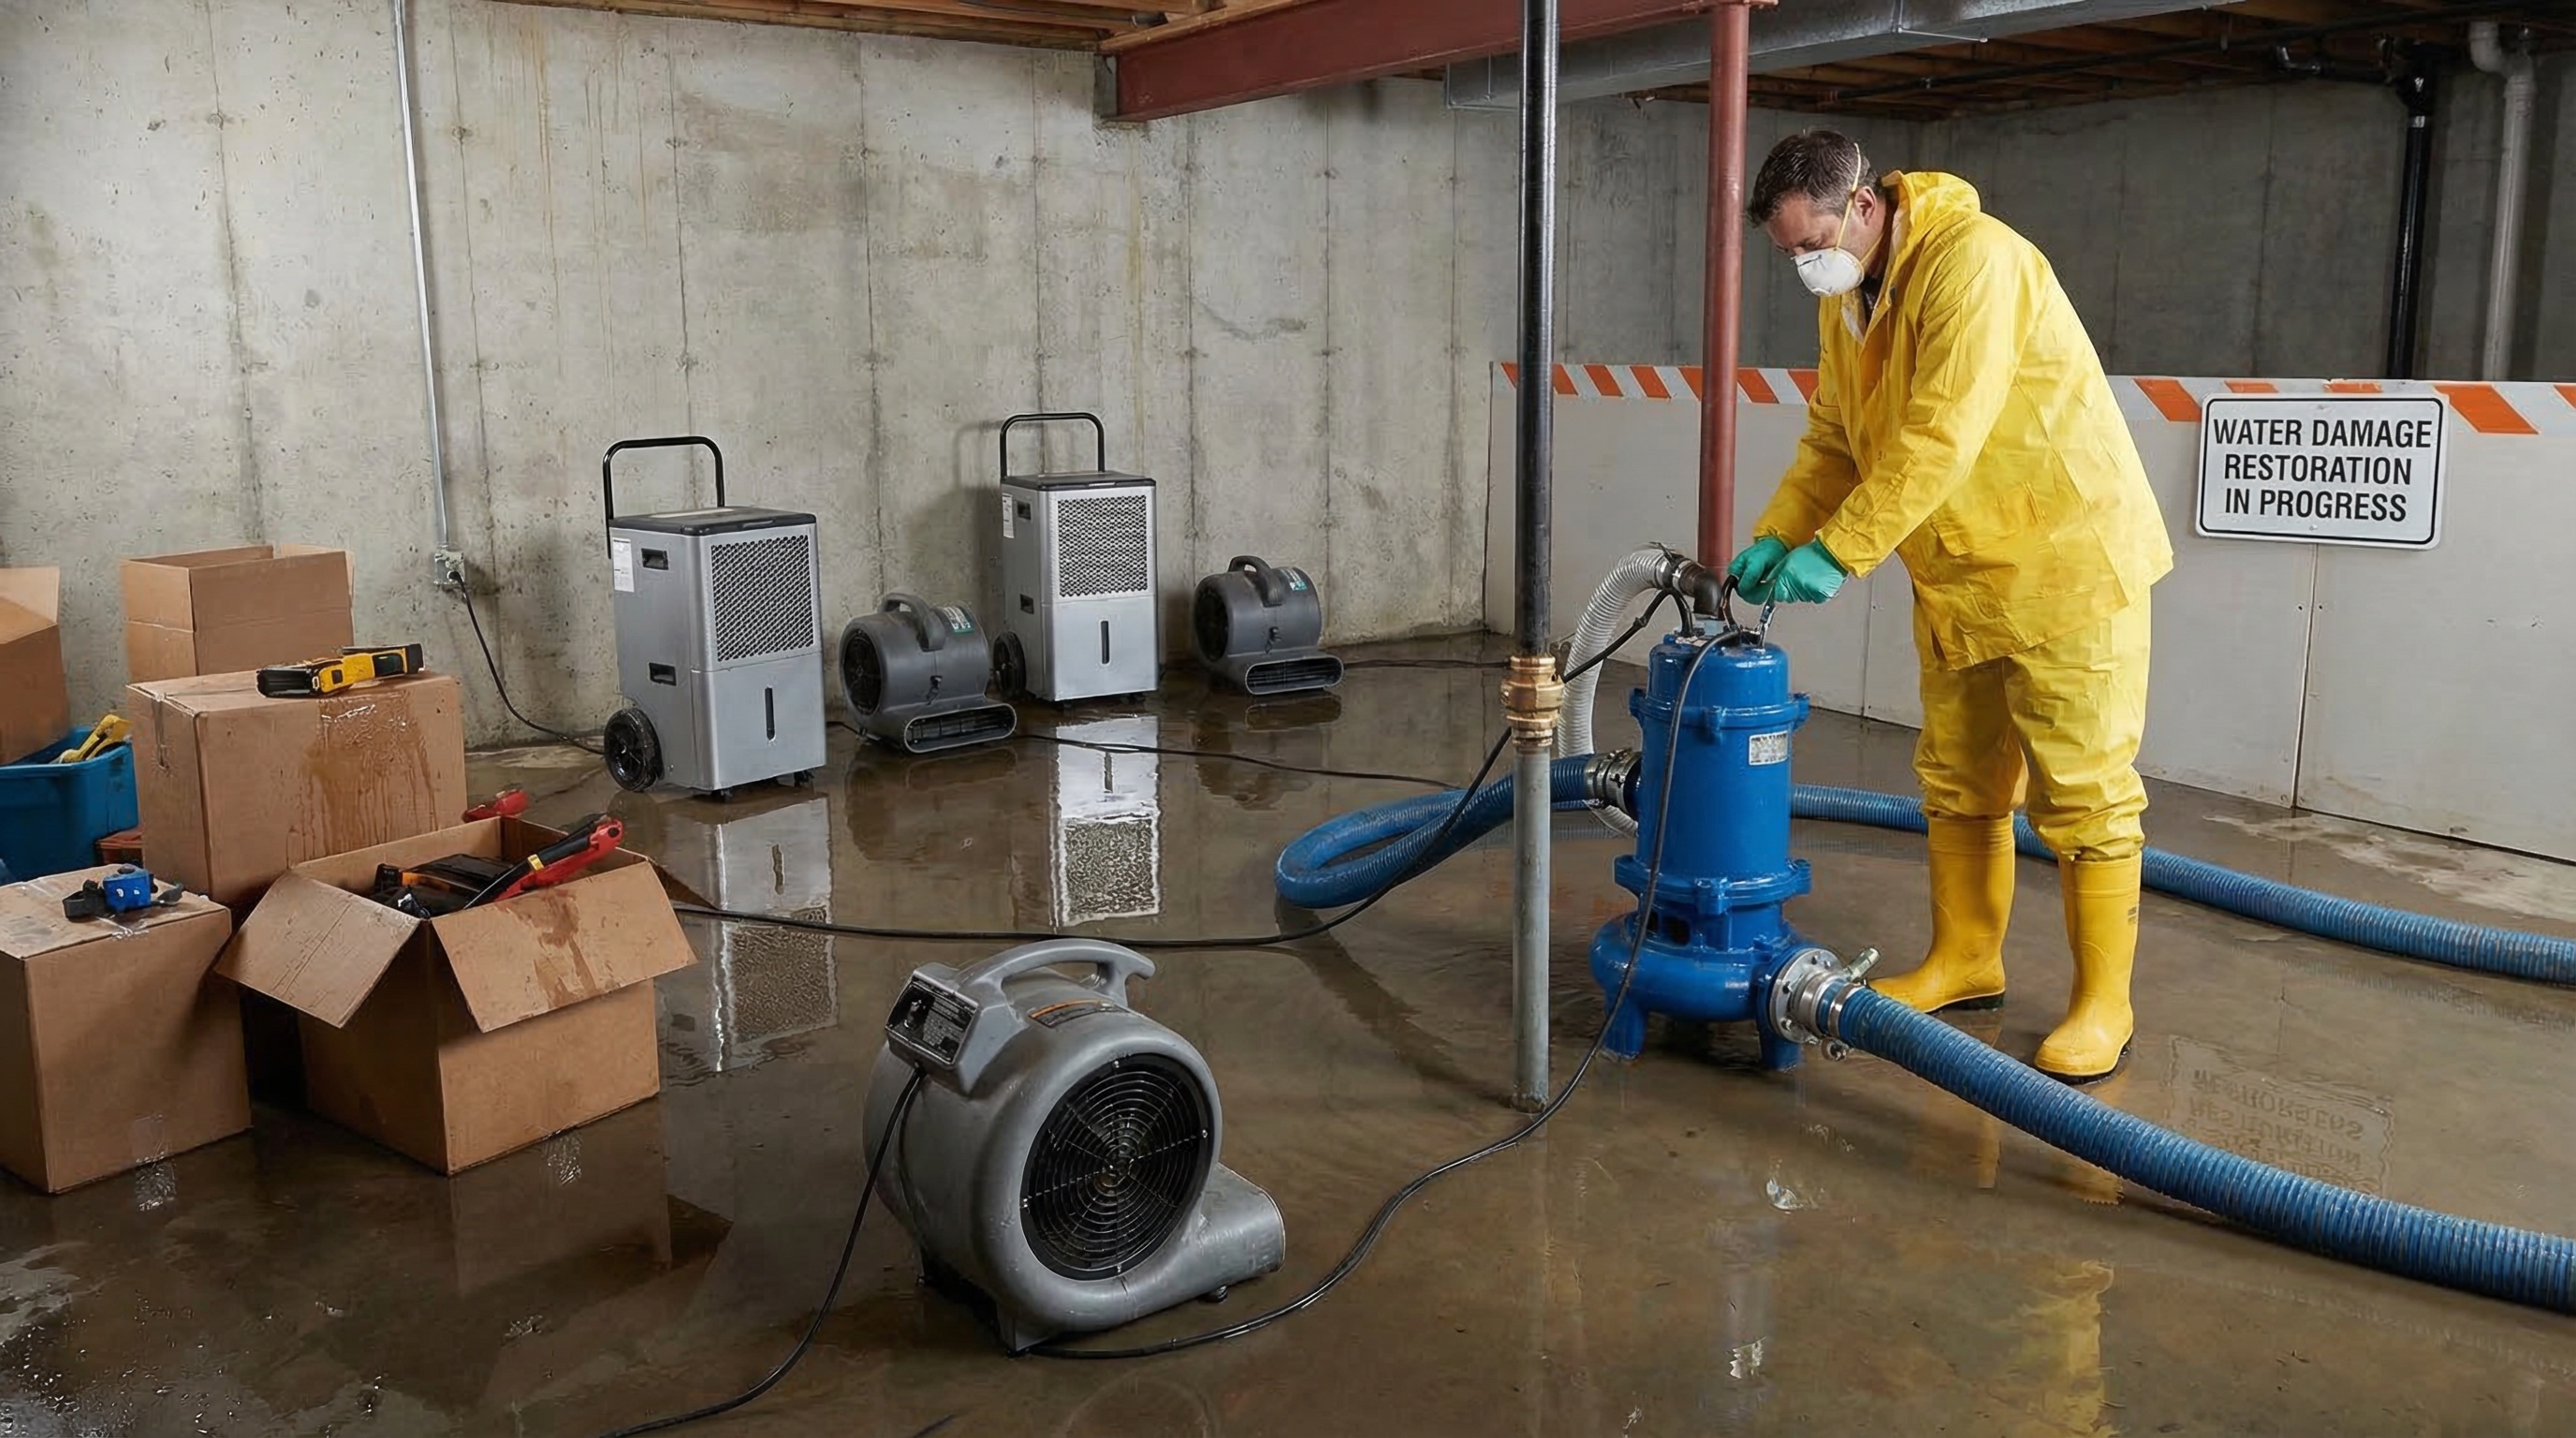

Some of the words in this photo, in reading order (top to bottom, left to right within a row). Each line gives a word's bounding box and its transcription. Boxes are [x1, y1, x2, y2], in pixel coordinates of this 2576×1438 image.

[2213, 418, 2303, 446] WATER
[2311, 419, 2433, 448] DAMAGE
[2224, 453, 2412, 485] RESTORATION
[2225, 488, 2250, 515] IN
[2260, 489, 2408, 522] PROGRESS
